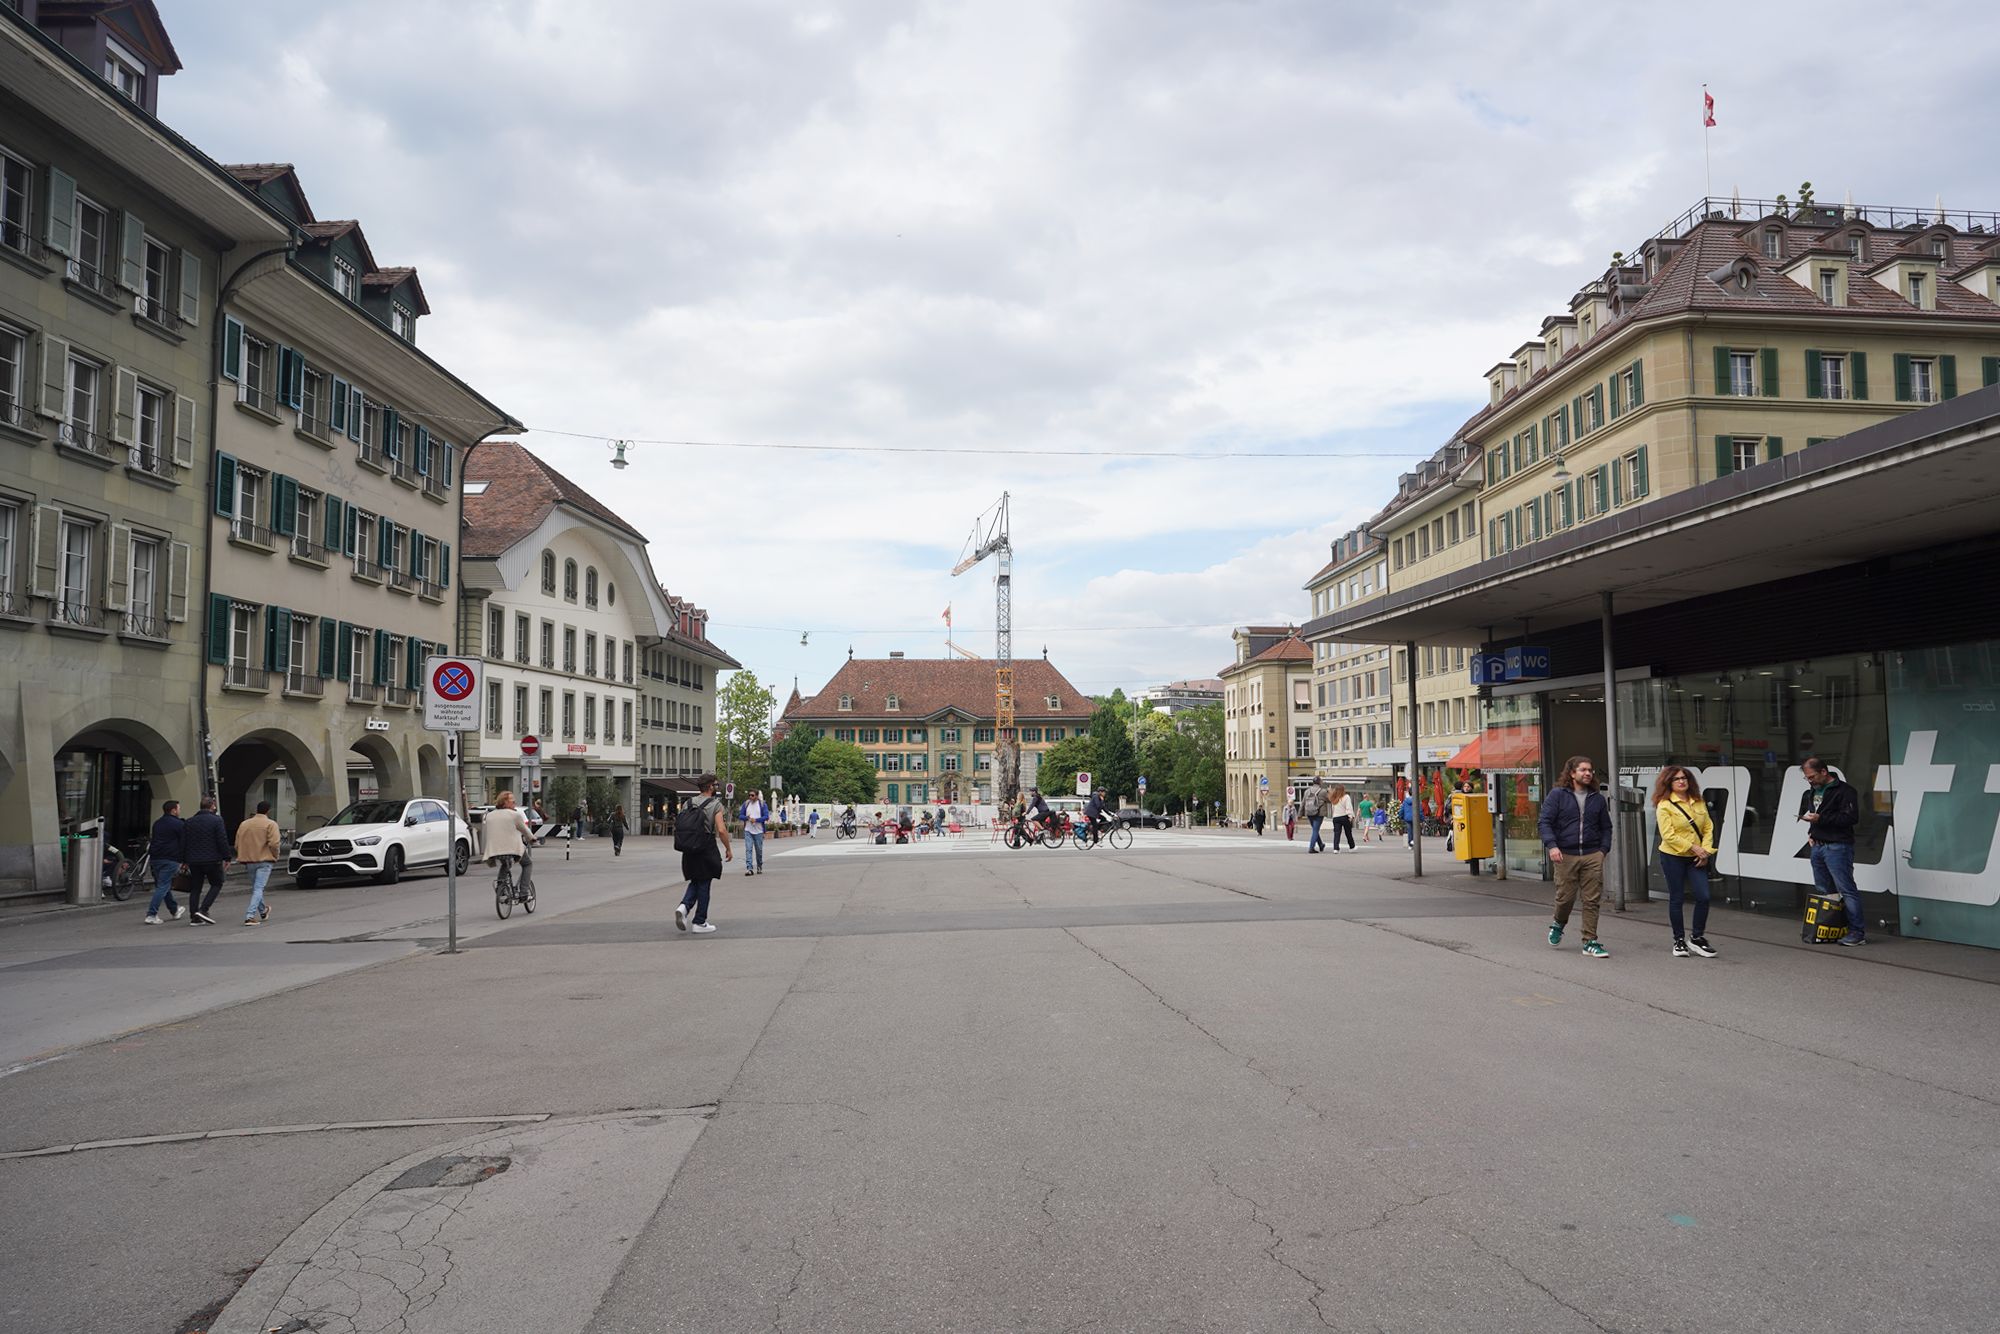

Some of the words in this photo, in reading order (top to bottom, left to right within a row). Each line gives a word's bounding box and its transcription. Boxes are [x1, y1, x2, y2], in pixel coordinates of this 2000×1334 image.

[1507, 656, 1520, 669] WC
[1523, 656, 1547, 668] WC
[1473, 664, 1480, 681] P
[1491, 663, 1504, 680] P
